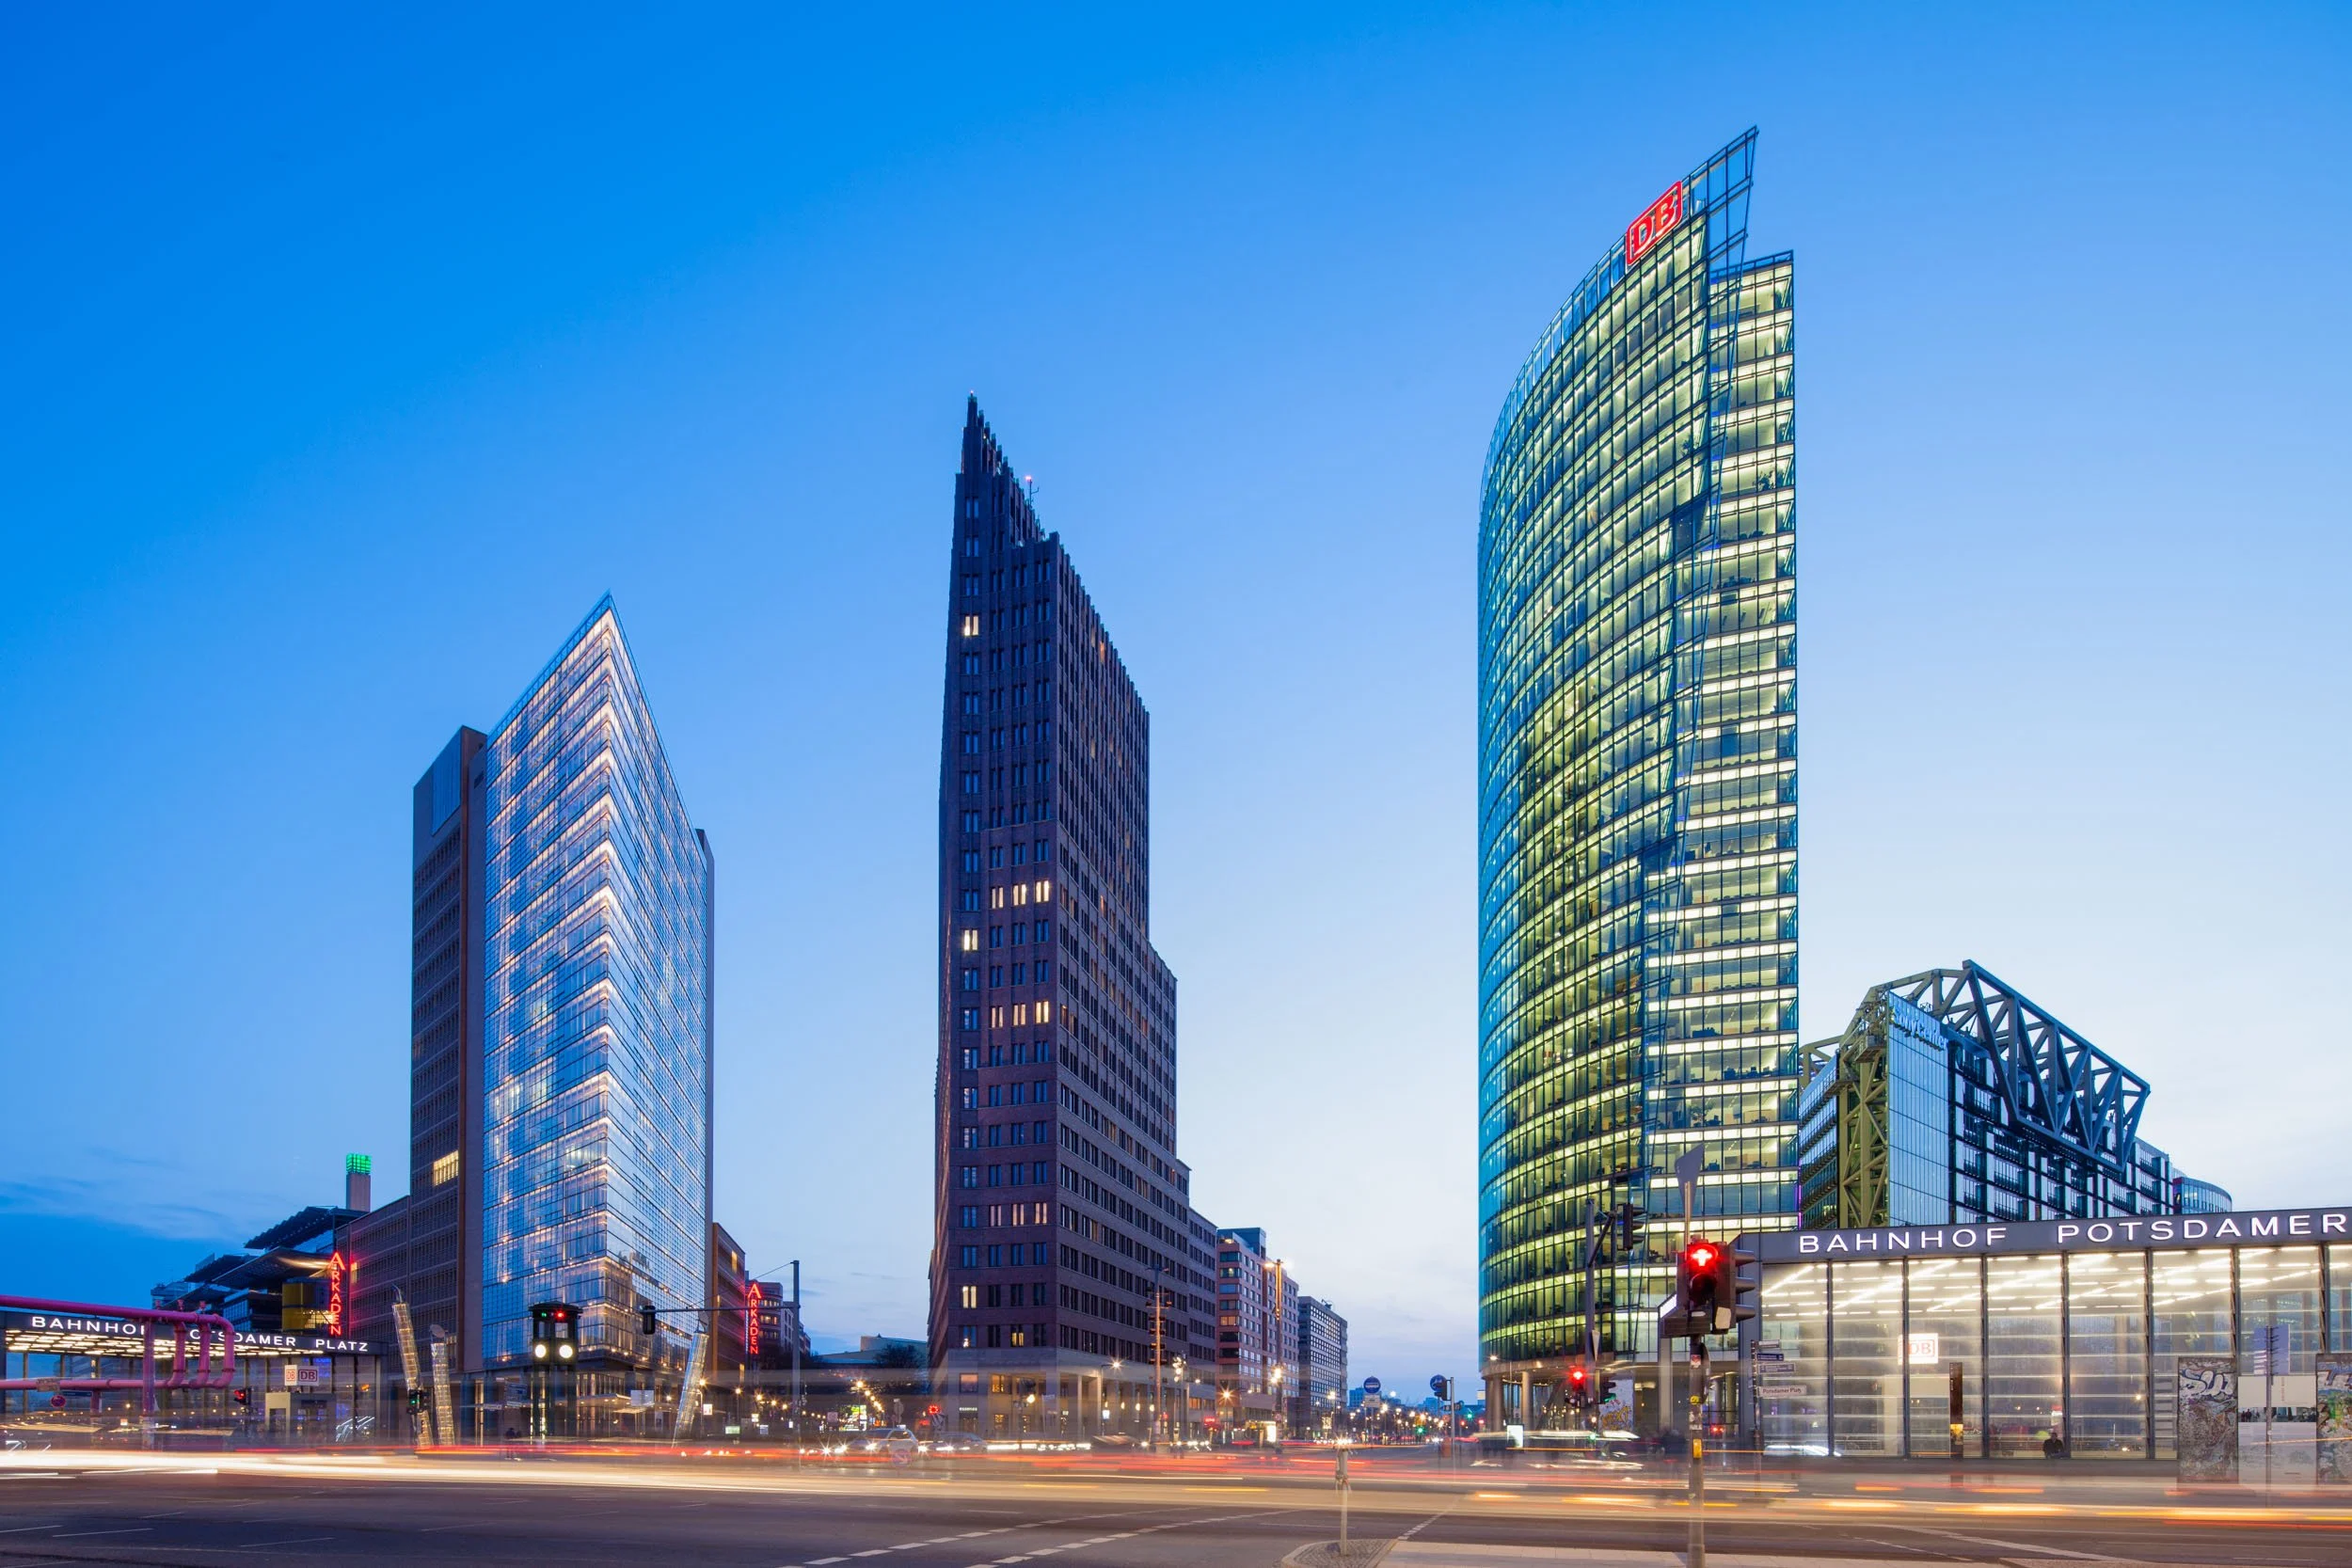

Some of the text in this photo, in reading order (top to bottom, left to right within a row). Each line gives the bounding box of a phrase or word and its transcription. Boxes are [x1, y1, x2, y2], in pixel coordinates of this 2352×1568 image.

[1631, 193, 1677, 256] DB
[1893, 1006, 1949, 1049] Sony Center
[1799, 1214, 2346, 1253] BAHNHOF POTSDAMER
[328, 1252, 346, 1335] ARKADEN
[747, 1283, 762, 1354] ARKADEN
[189, 1329, 296, 1346] OSDAMER
[315, 1338, 369, 1352] PLATZ
[1908, 1341, 1931, 1354] DB
[286, 1370, 295, 1380] DB
[300, 1370, 316, 1380] DB
